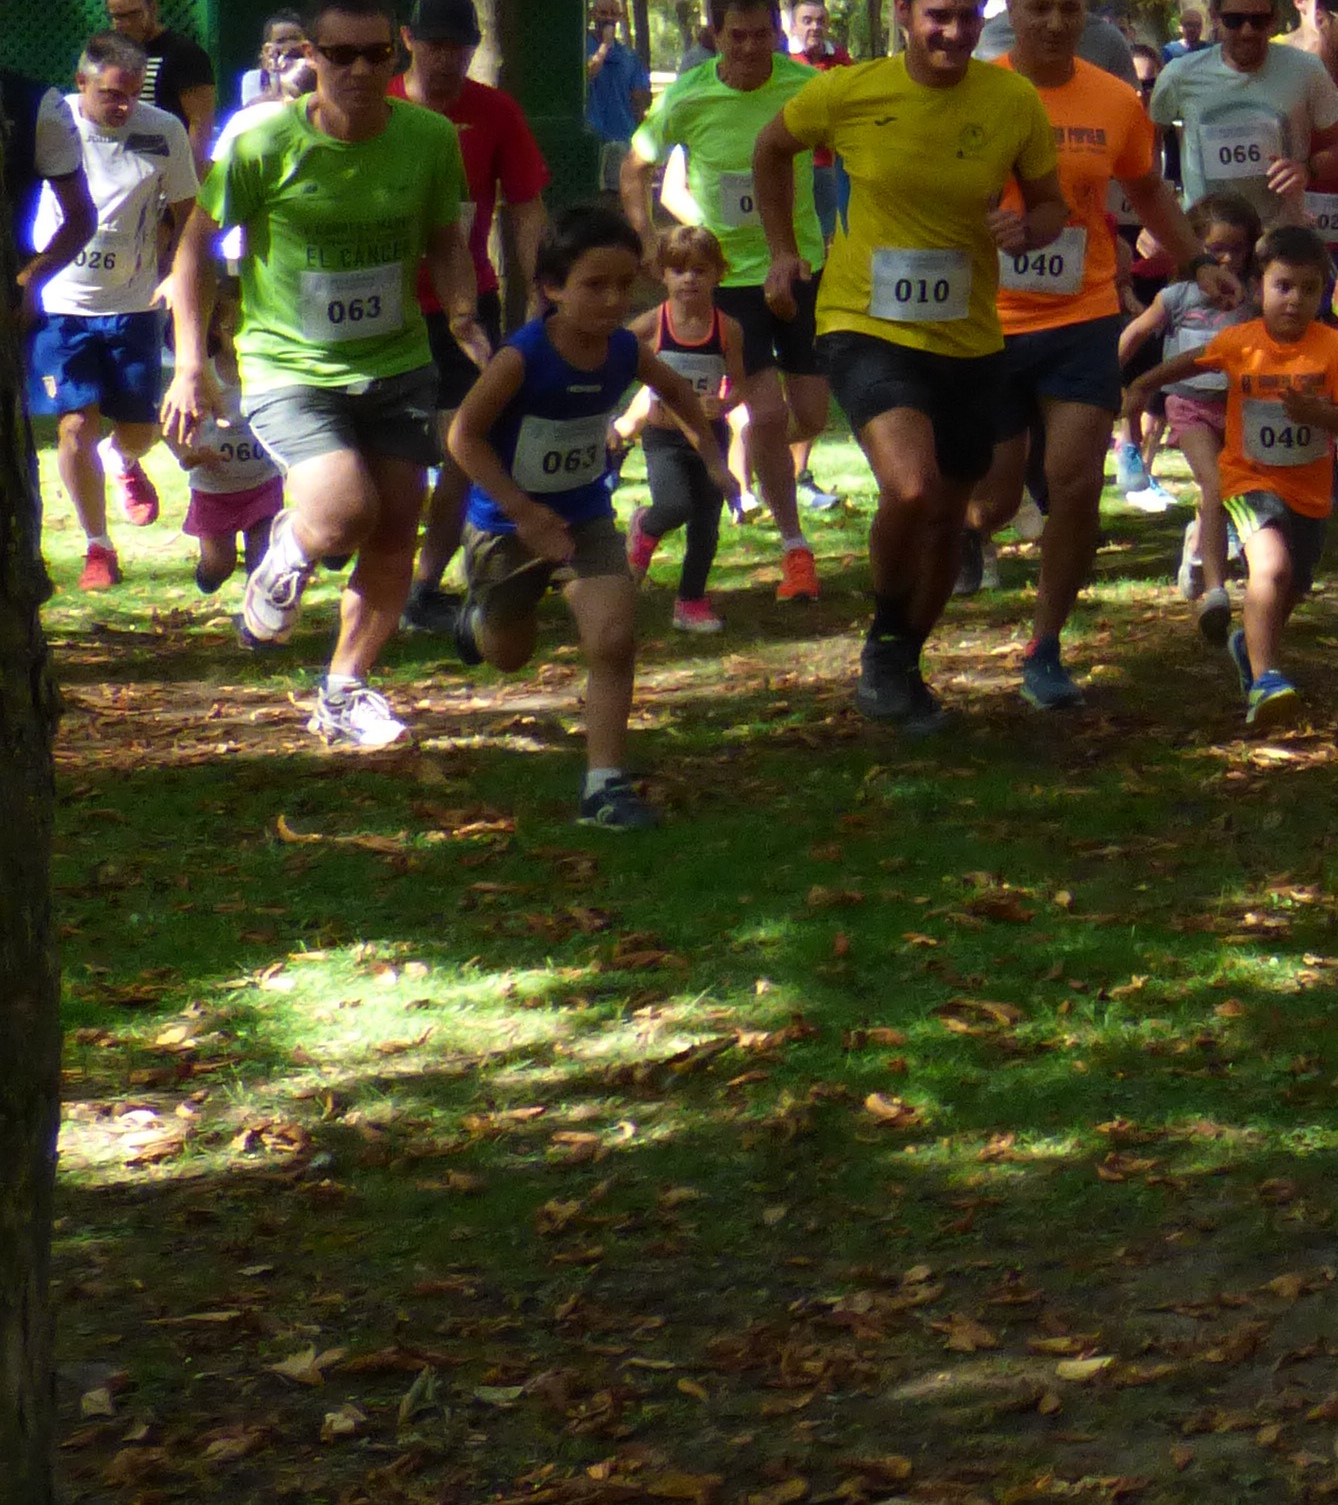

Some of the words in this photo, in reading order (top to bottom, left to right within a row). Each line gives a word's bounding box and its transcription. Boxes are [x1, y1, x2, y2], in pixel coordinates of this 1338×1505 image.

[1218, 143, 1261, 165] 066
[1013, 253, 1064, 277] 040
[894, 278, 950, 304] 010
[327, 295, 381, 324] 063
[1259, 425, 1311, 449] 040
[542, 444, 598, 475] 063
